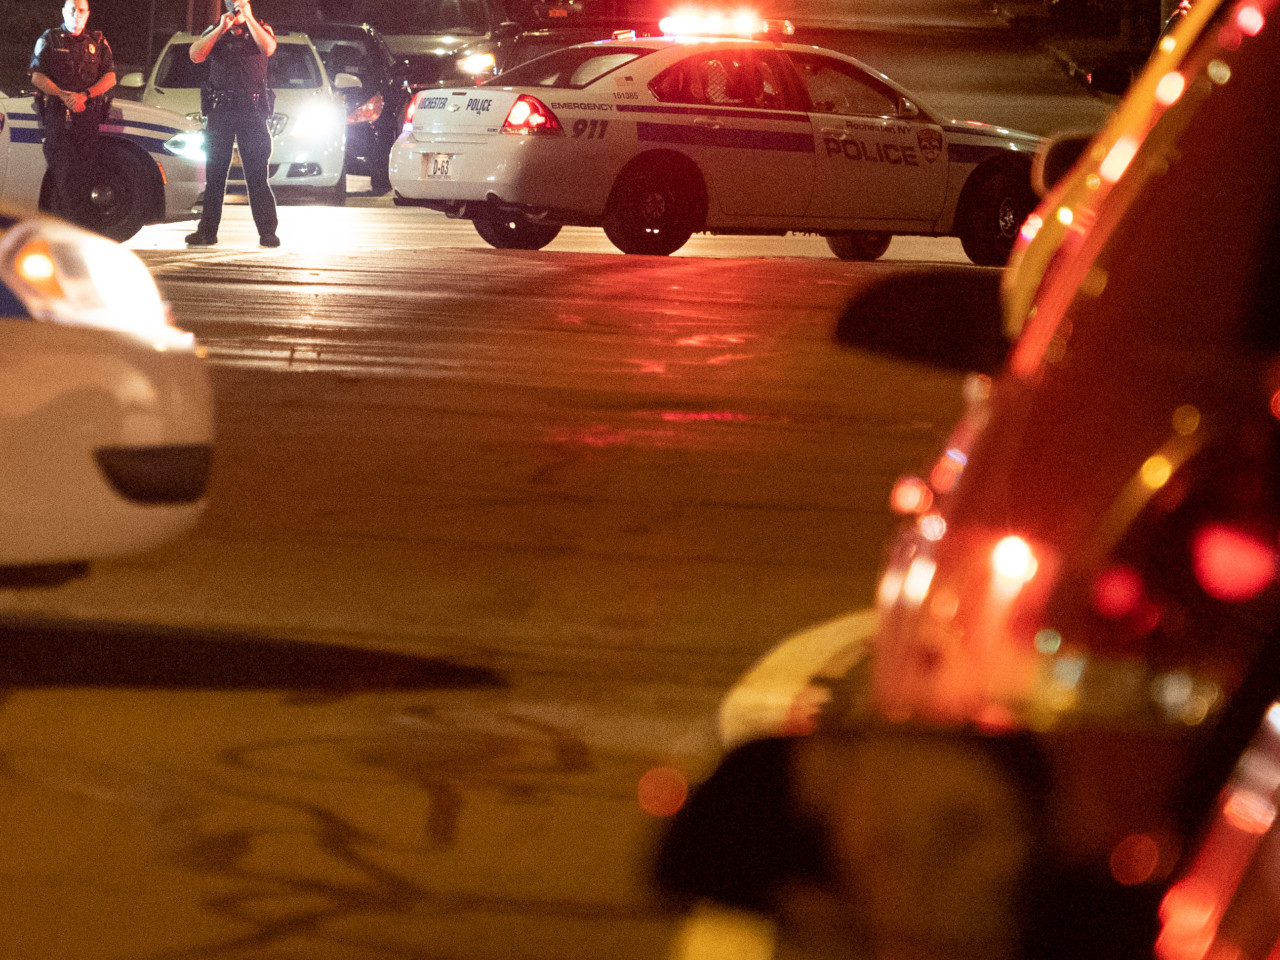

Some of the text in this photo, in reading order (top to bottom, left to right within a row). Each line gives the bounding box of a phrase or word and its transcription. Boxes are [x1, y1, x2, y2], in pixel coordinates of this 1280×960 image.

[466, 98, 493, 112] POLICE
[551, 102, 614, 111] EMERGENCY
[571, 118, 609, 140] 911
[897, 125, 913, 135] NY
[823, 137, 920, 167] POLICE
[432, 159, 450, 176] D-63
